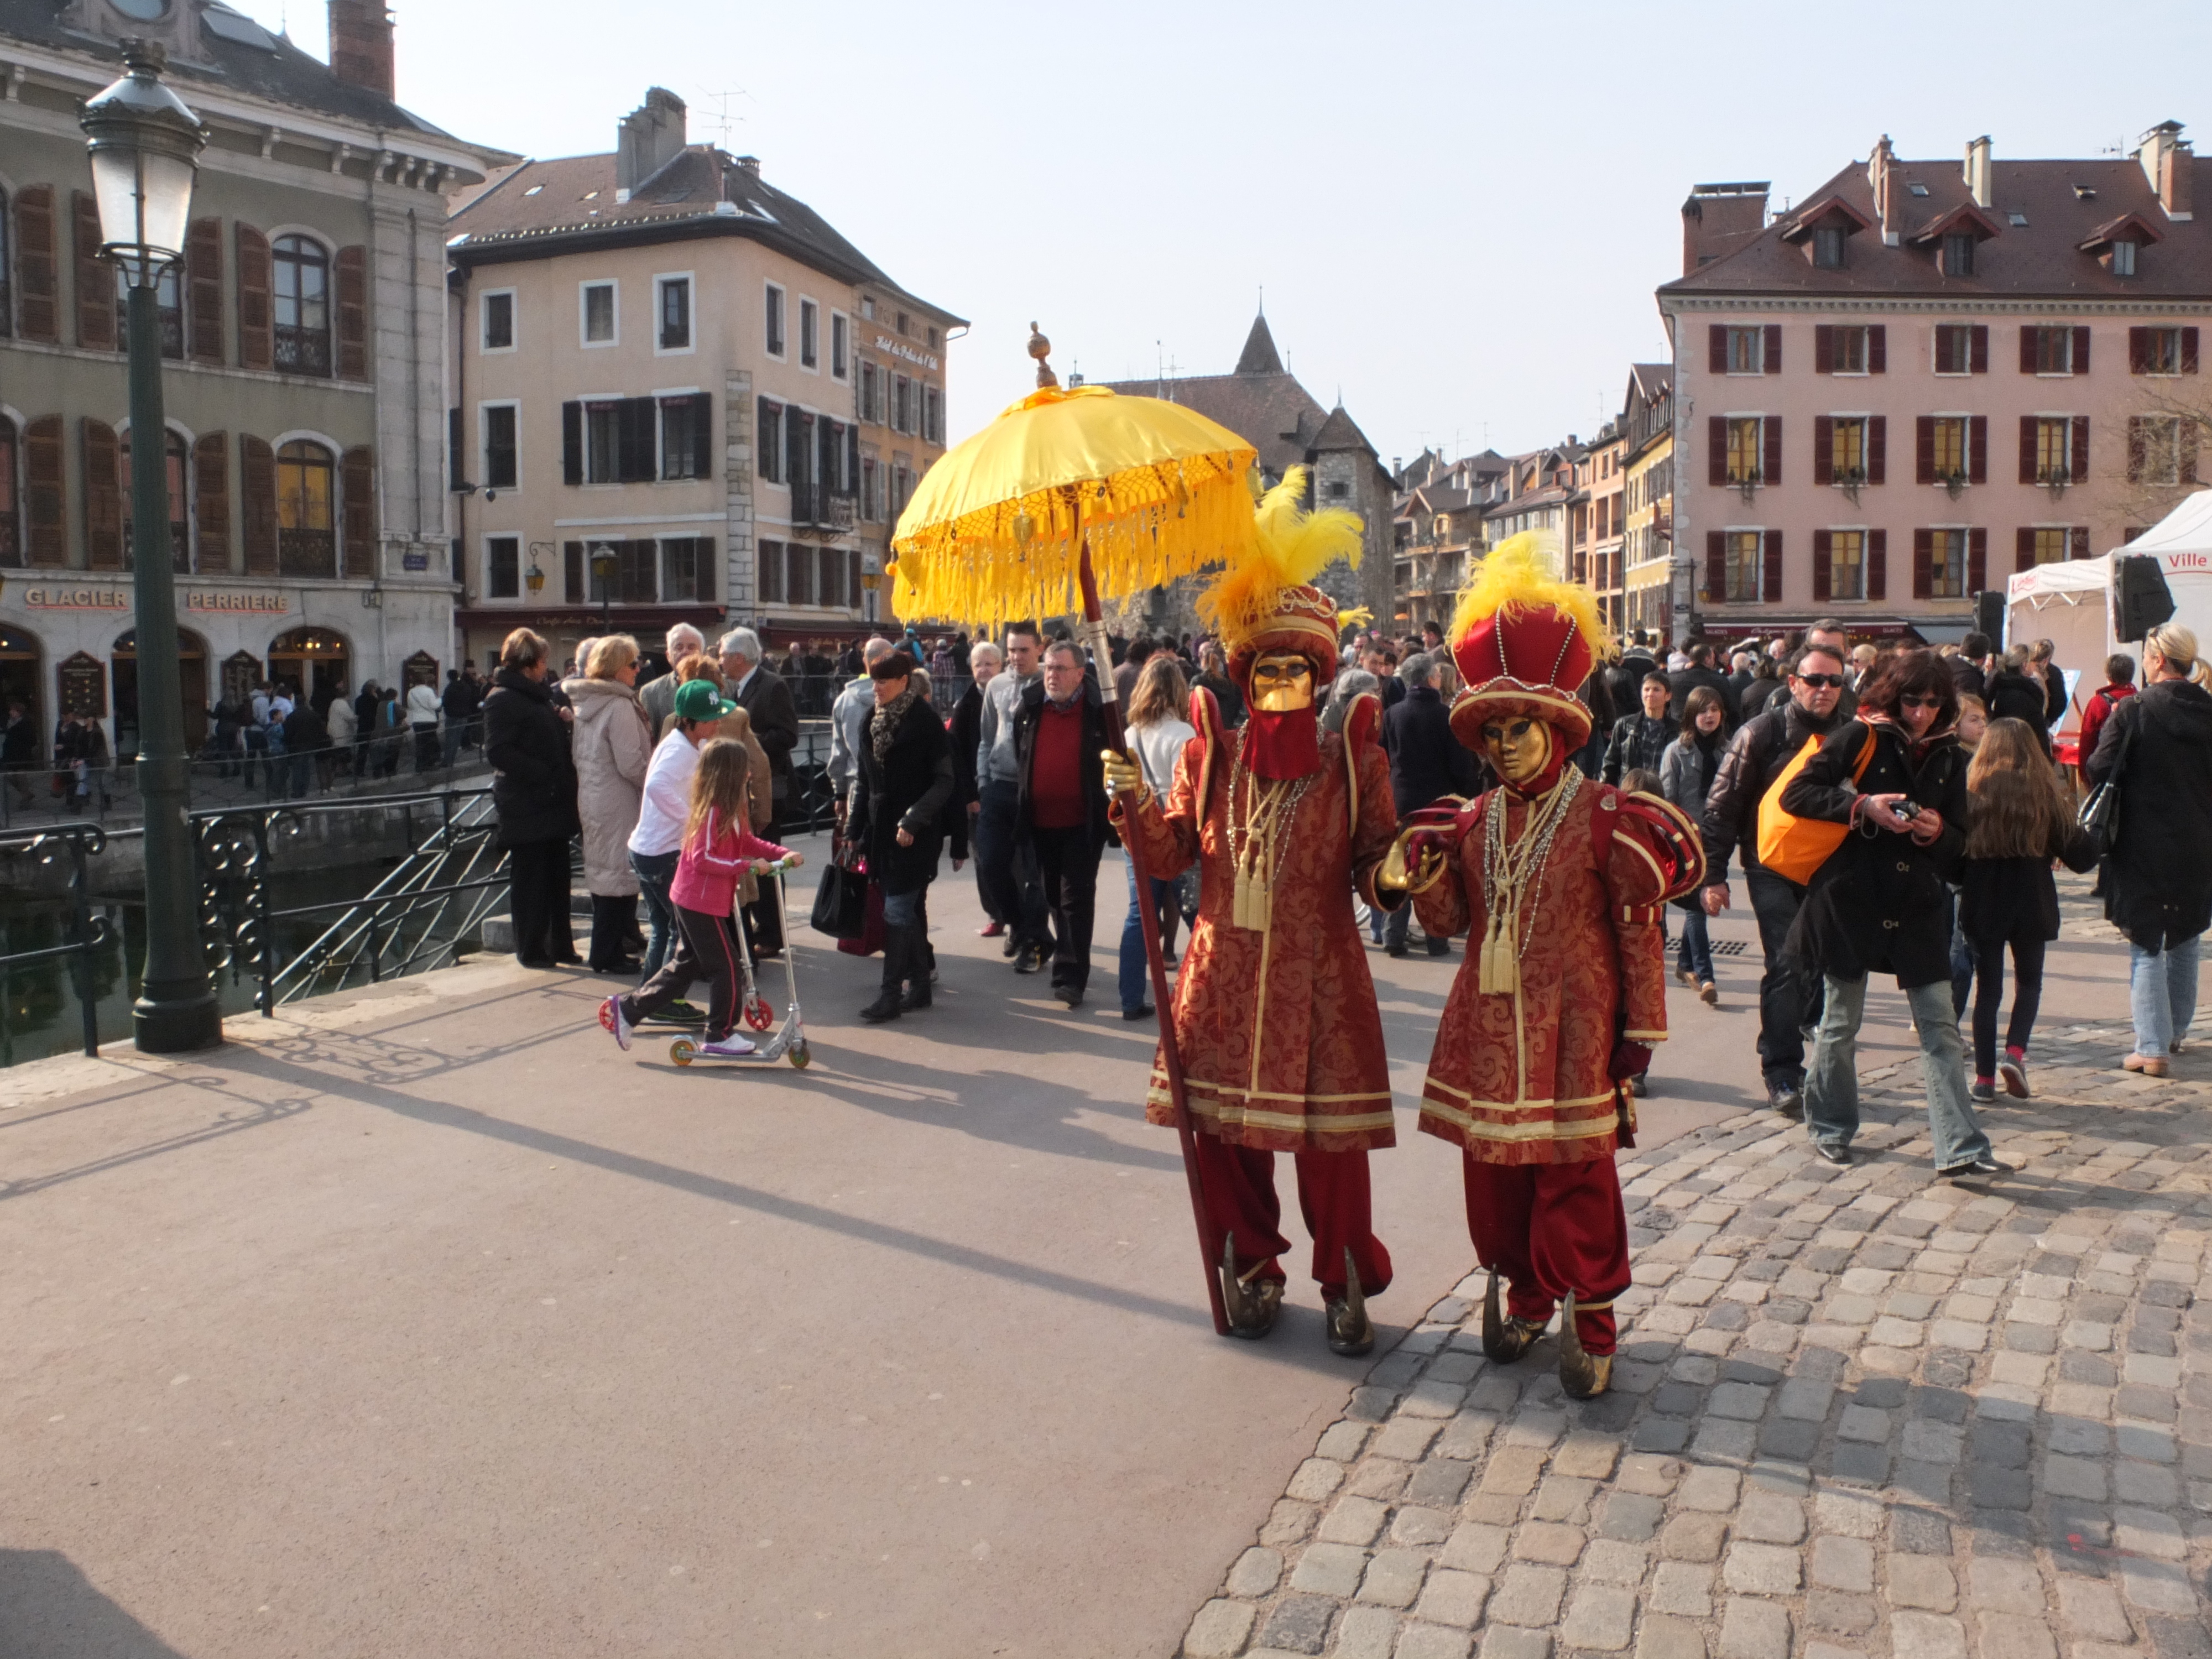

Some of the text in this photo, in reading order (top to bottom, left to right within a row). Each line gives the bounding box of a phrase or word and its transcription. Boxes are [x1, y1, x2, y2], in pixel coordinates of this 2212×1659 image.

[2168, 553, 2208, 567] Ville
[25, 588, 289, 611] GLACIER PERRIERE
